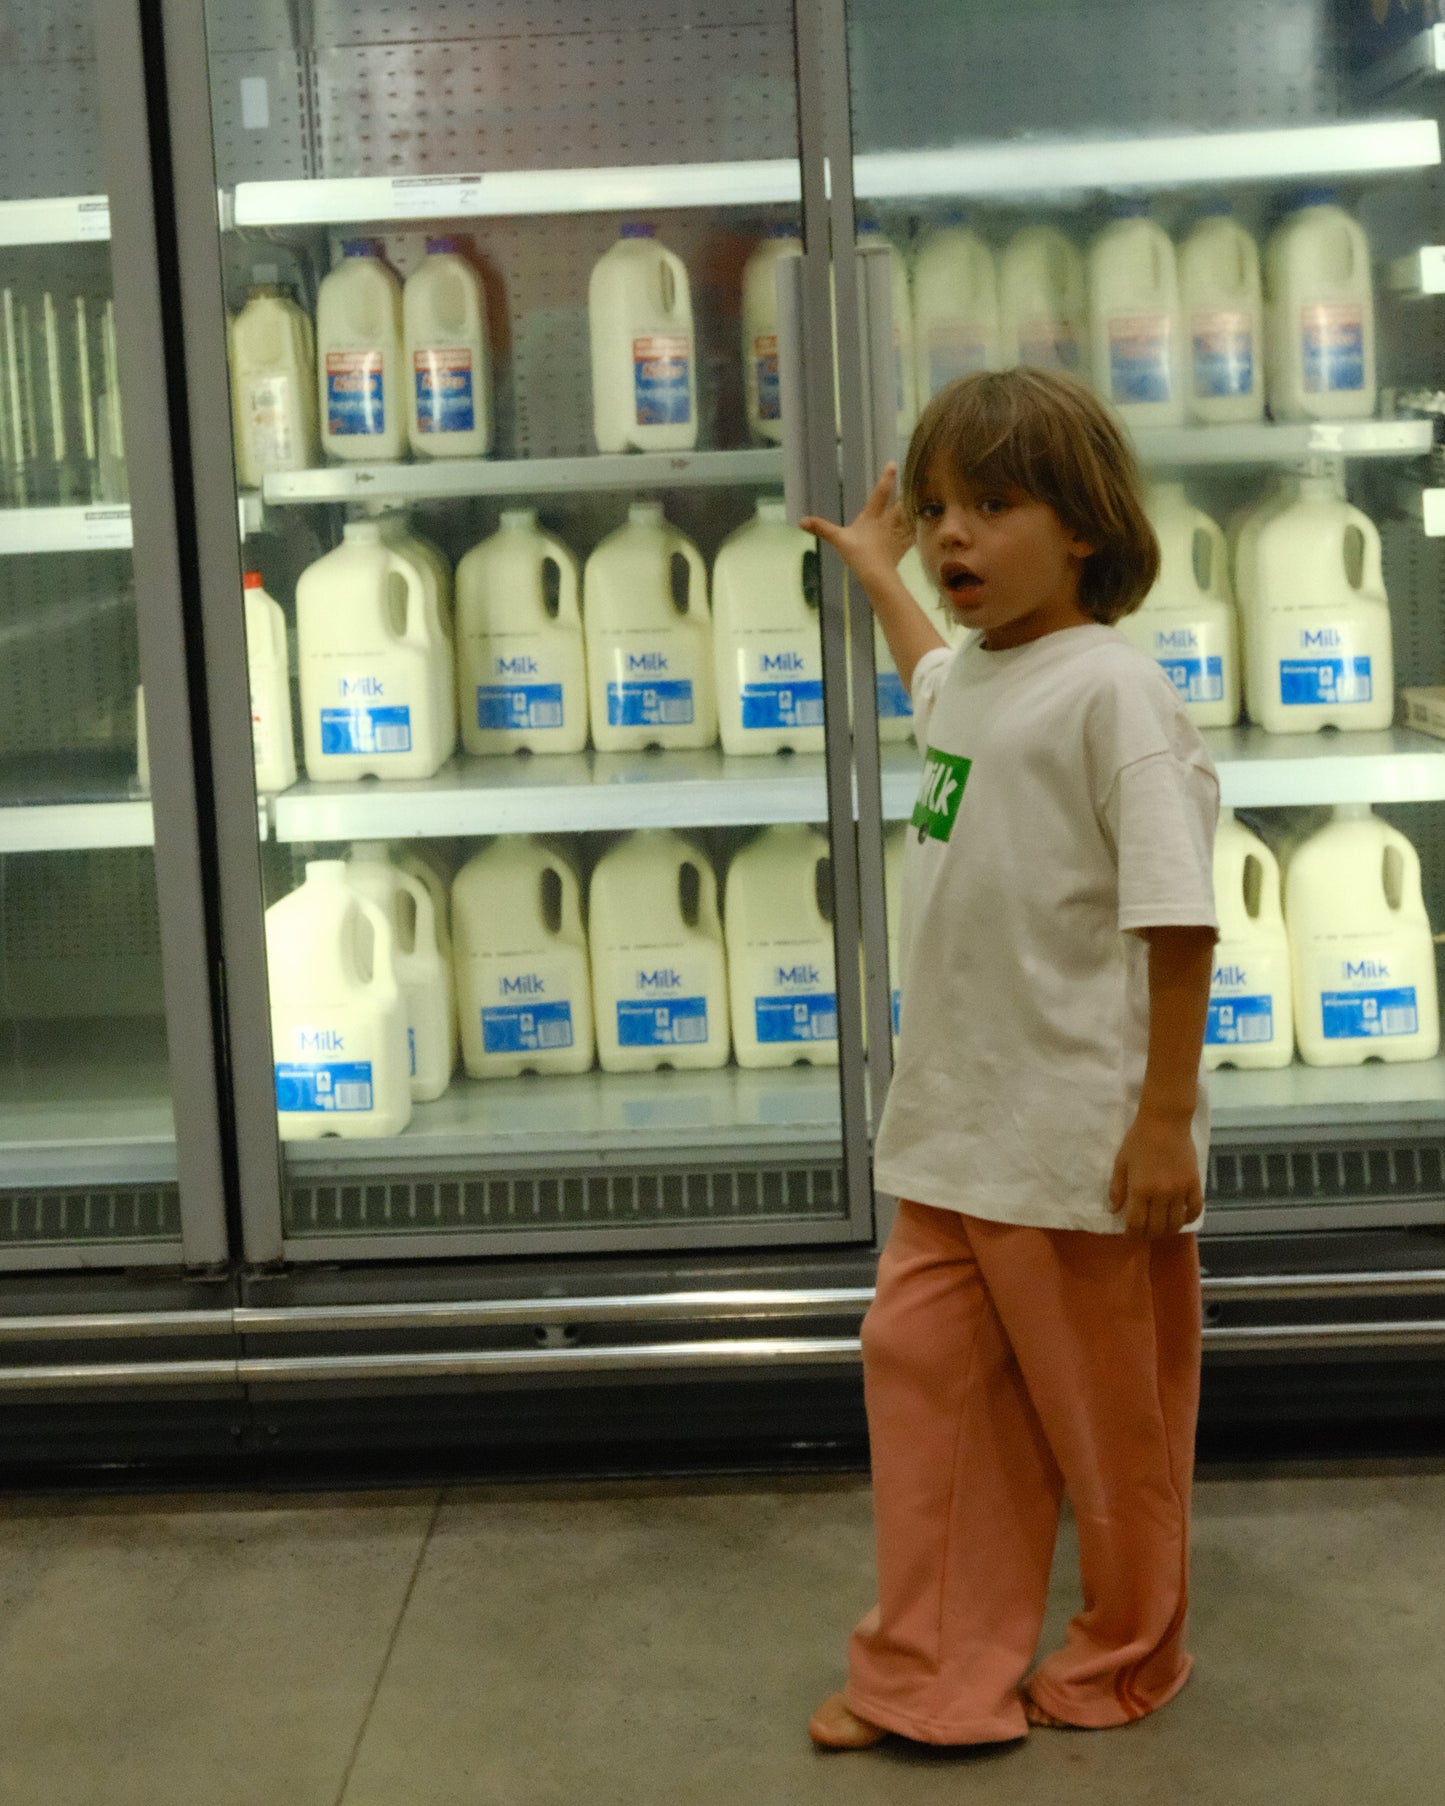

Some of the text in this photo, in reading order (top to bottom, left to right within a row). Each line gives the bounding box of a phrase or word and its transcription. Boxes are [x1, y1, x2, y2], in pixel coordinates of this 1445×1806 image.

[1156, 628, 1198, 648] Milk
[498, 656, 537, 674] Milk
[629, 652, 668, 671] Milk
[764, 652, 804, 672] Milk
[340, 676, 384, 696] Milk
[637, 969, 681, 988] Milk
[777, 965, 819, 985] Milk
[1346, 959, 1389, 980] Milk
[501, 973, 545, 994] Milk
[300, 1029, 344, 1051] Milk
